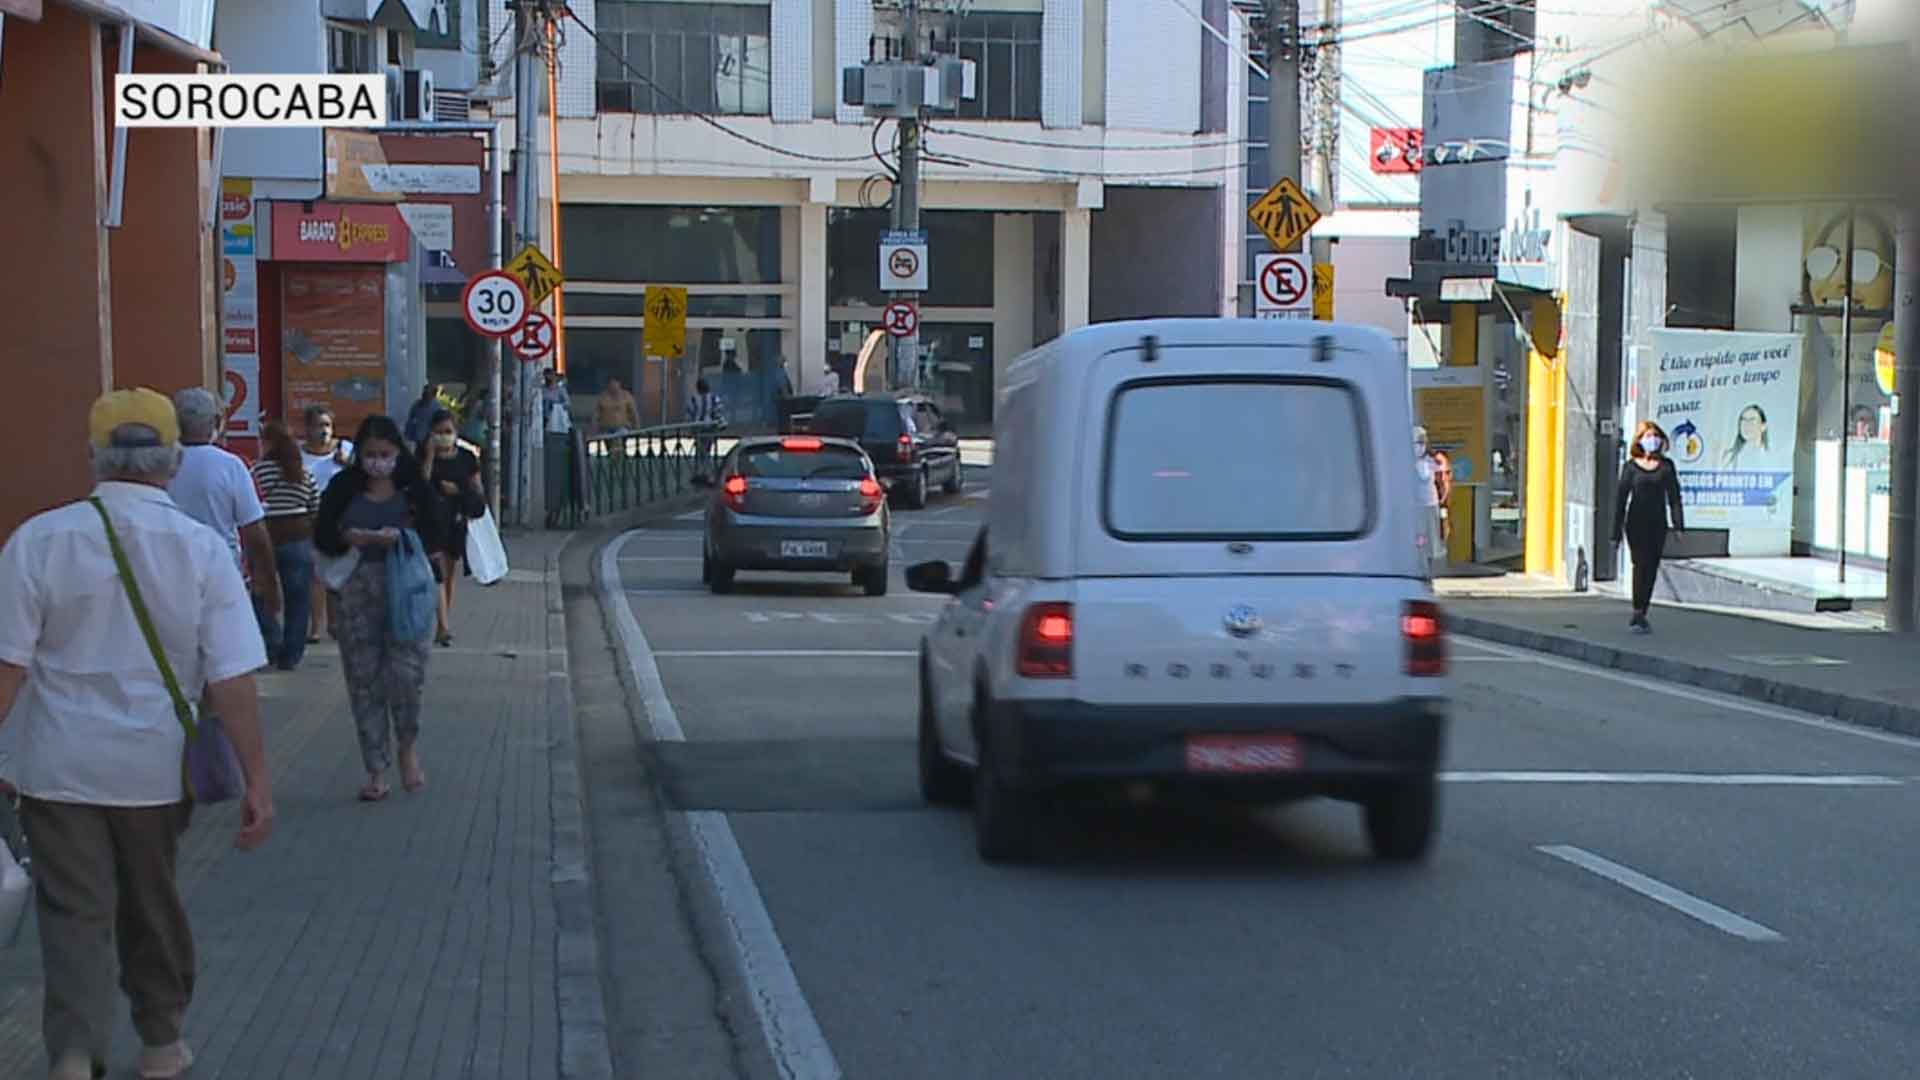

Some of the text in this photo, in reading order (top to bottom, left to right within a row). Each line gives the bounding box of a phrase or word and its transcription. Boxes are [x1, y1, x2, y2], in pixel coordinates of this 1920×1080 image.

[300, 220, 336, 241] BARATO
[353, 224, 389, 241] EXPRESS
[477, 288, 516, 315] 30
[1670, 355, 1691, 370] tão
[1695, 351, 1737, 369] rápido
[1738, 350, 1760, 366] que
[1763, 344, 1792, 359] você
[1658, 369, 1781, 393] nem vai ver o tempo
[1681, 473, 1774, 489] CULOS PRONTO EM
[1697, 491, 1744, 505] MINUTOS
[1125, 662, 1358, 681] ROBUST
